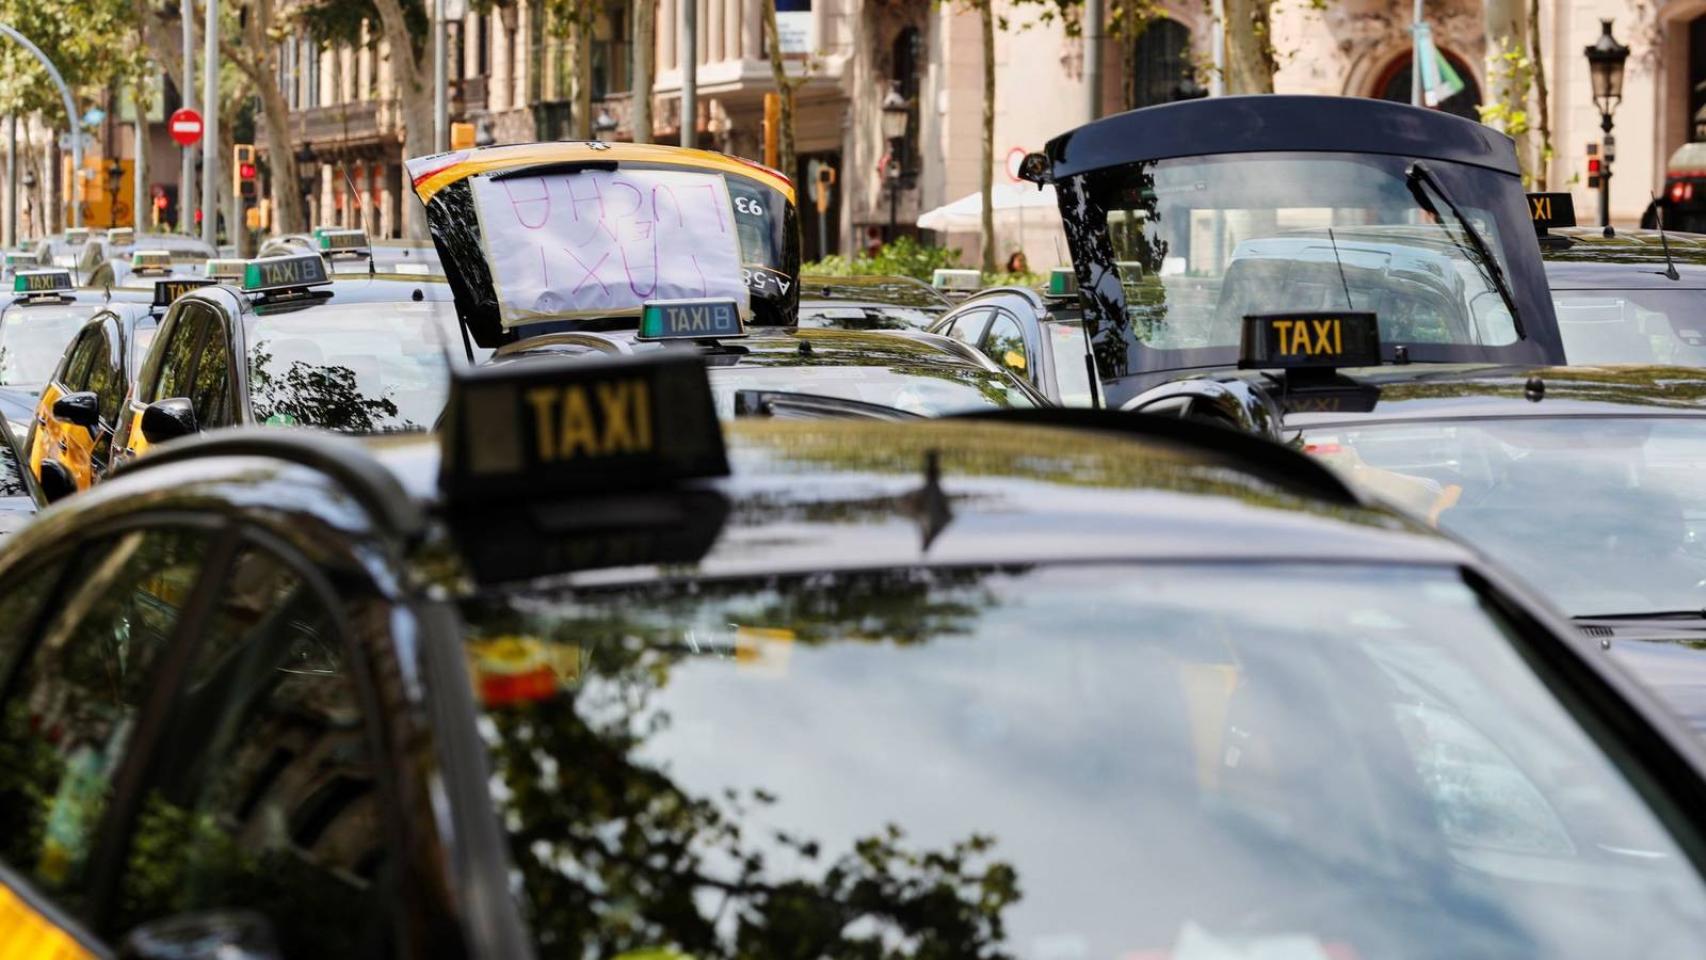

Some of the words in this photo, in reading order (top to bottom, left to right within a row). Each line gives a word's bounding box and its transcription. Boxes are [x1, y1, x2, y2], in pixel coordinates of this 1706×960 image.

[502, 177, 724, 232] LUCHA
[735, 197, 763, 216] 93
[1530, 197, 1552, 220] XI
[28, 275, 54, 289] TAXI
[263, 261, 299, 284] TAXI
[668, 307, 710, 332] TAXI
[1272, 319, 1342, 355] TAXI
[526, 381, 652, 463] TAXI
